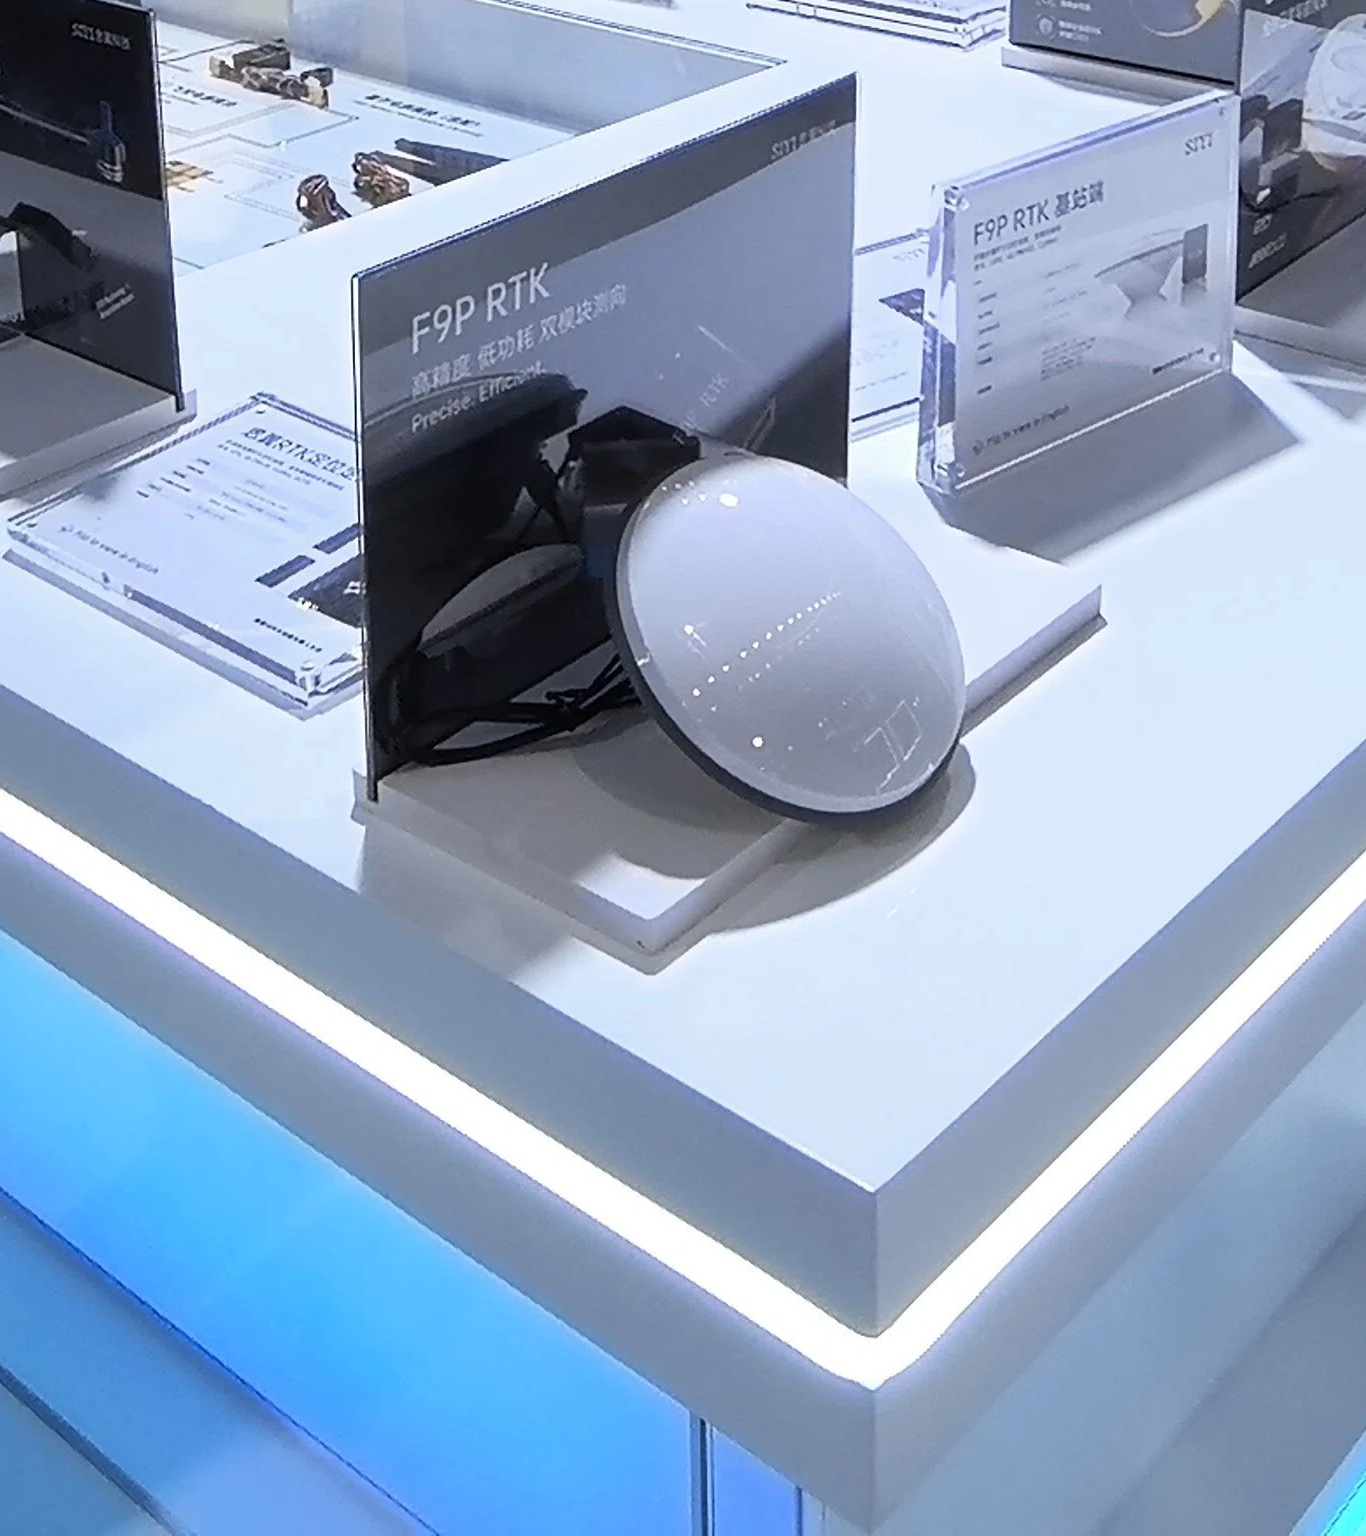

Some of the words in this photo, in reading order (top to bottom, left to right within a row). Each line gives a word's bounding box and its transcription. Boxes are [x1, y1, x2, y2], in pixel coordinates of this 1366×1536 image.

[973, 213, 1009, 247] F9P
[1013, 198, 1051, 232] RTK
[411, 294, 476, 356] F9P
[485, 261, 552, 324] RTK
